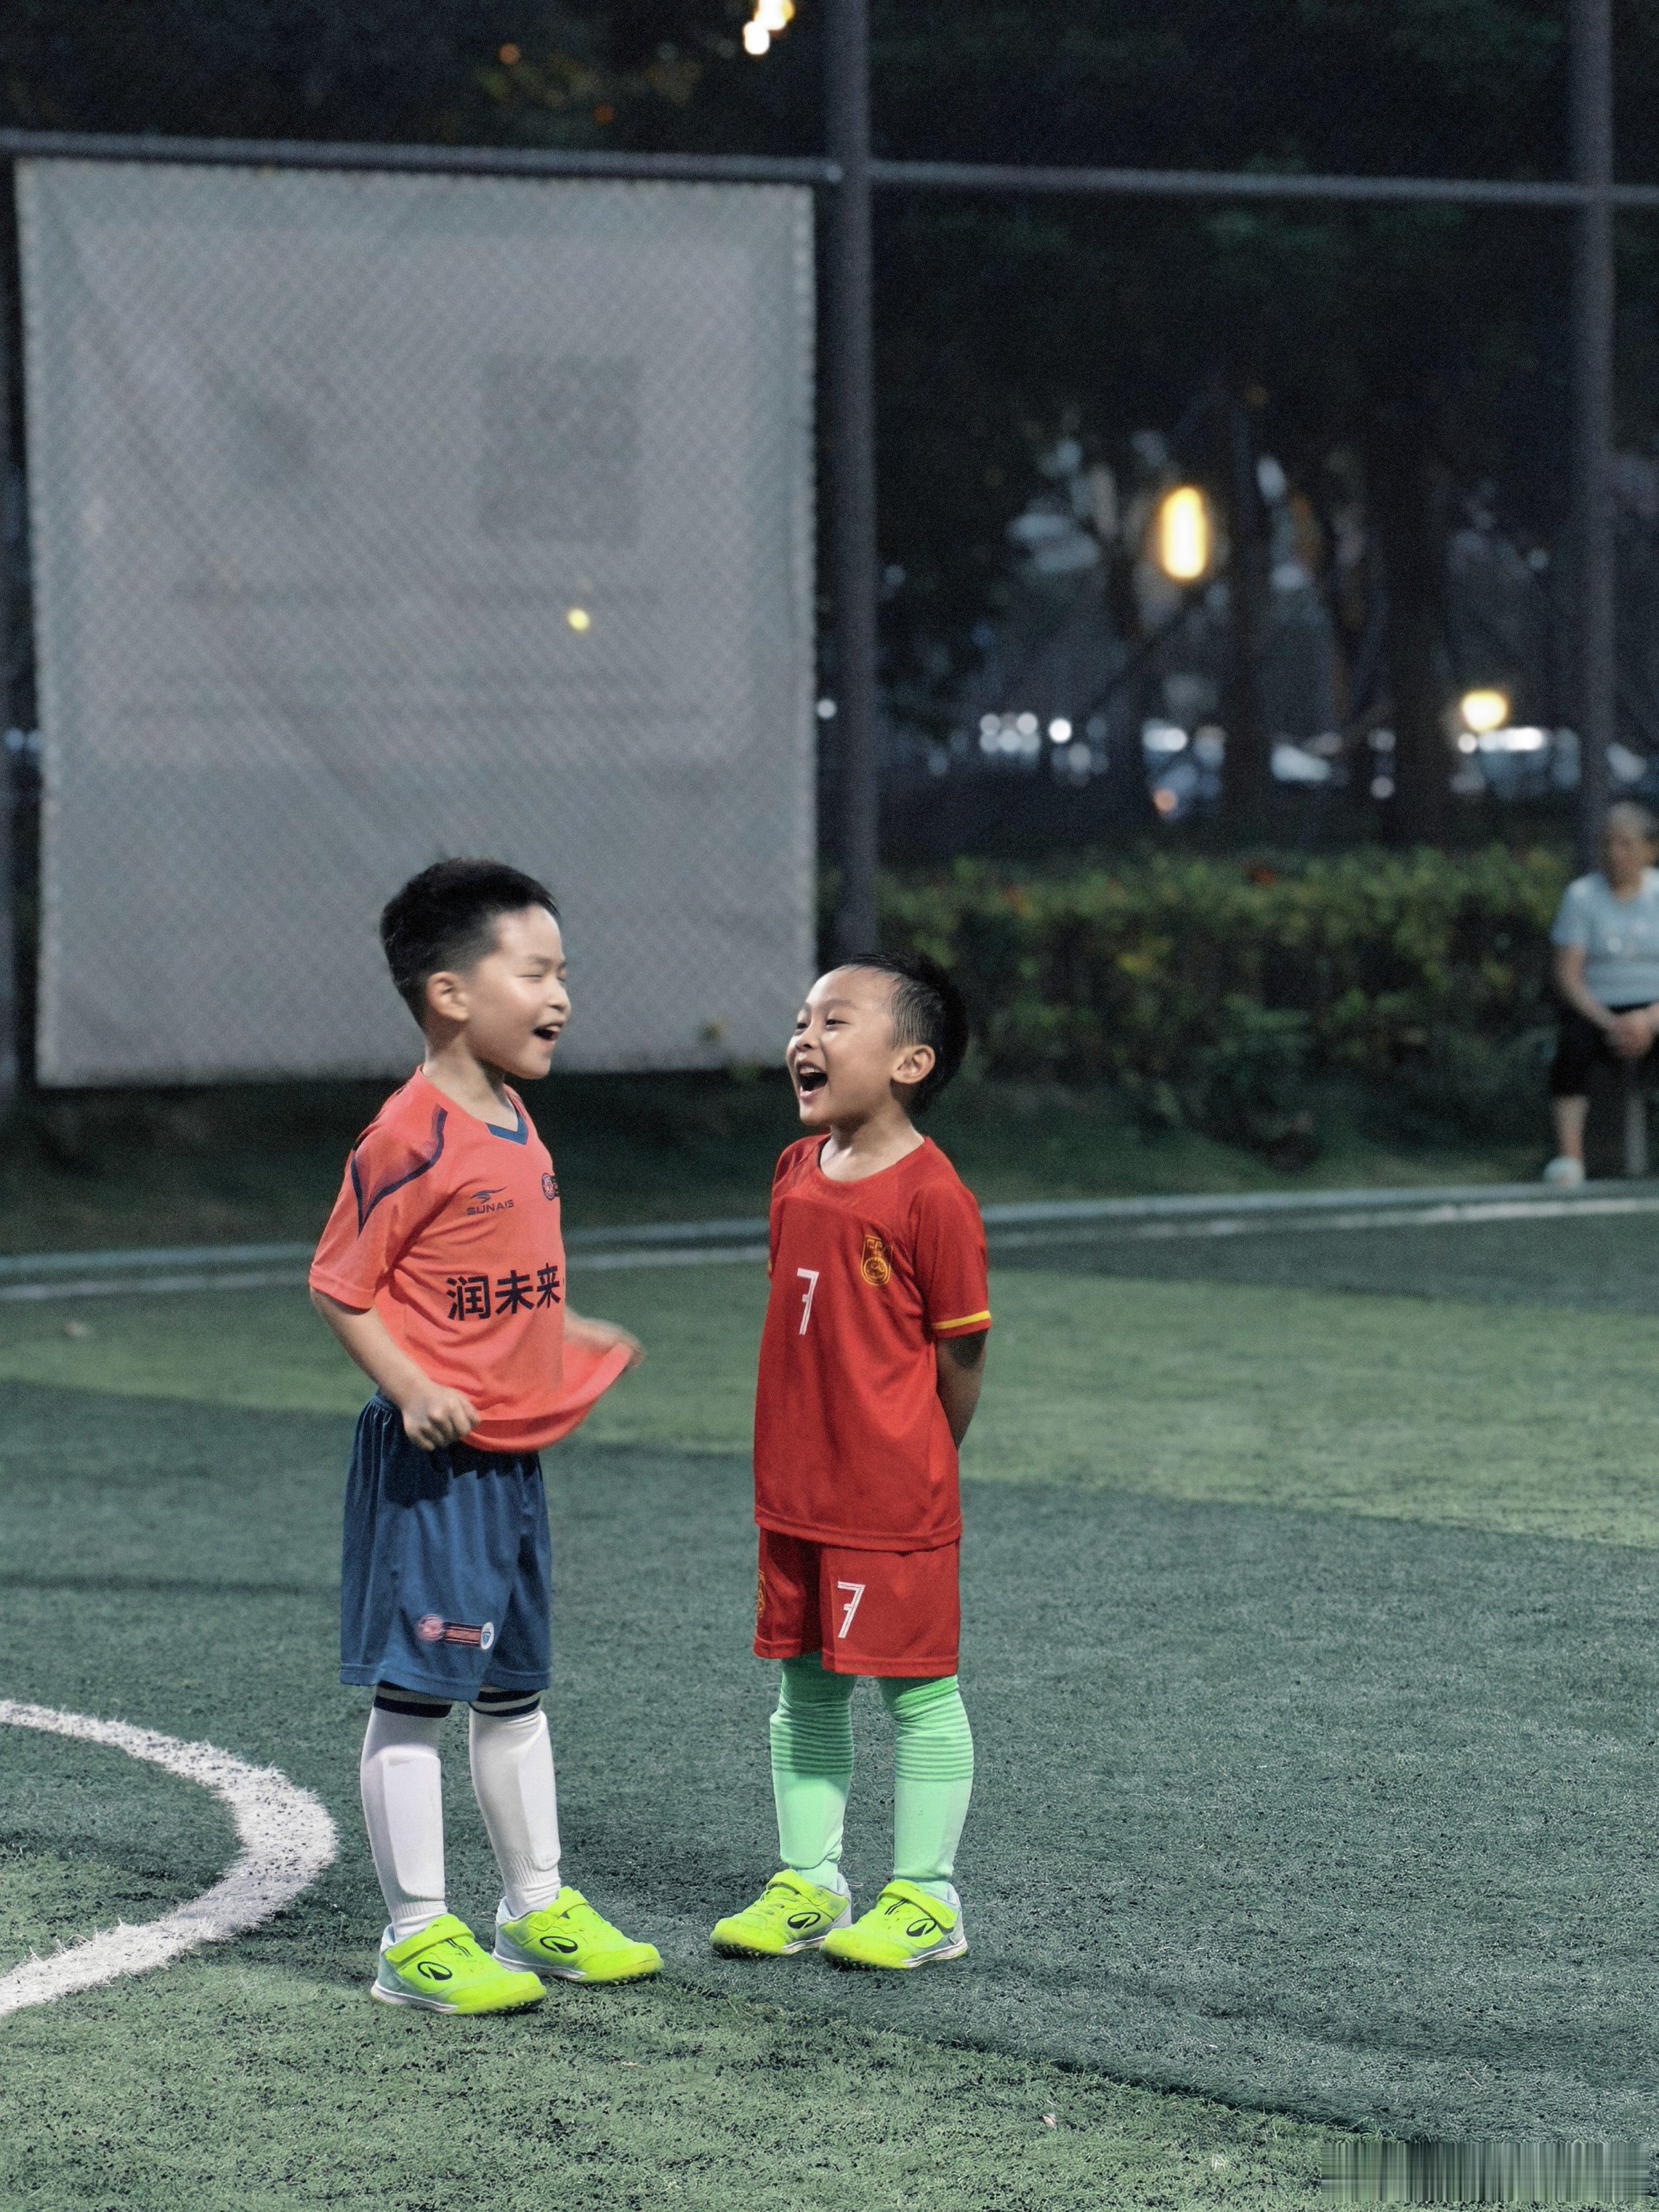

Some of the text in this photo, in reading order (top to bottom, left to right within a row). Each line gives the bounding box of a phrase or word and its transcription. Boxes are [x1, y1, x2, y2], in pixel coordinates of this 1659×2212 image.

[467, 1199, 514, 1215] SUNAIS
[446, 1263, 561, 1321] 润未来
[797, 1267, 819, 1335] 7
[838, 1581, 866, 1638] 7
